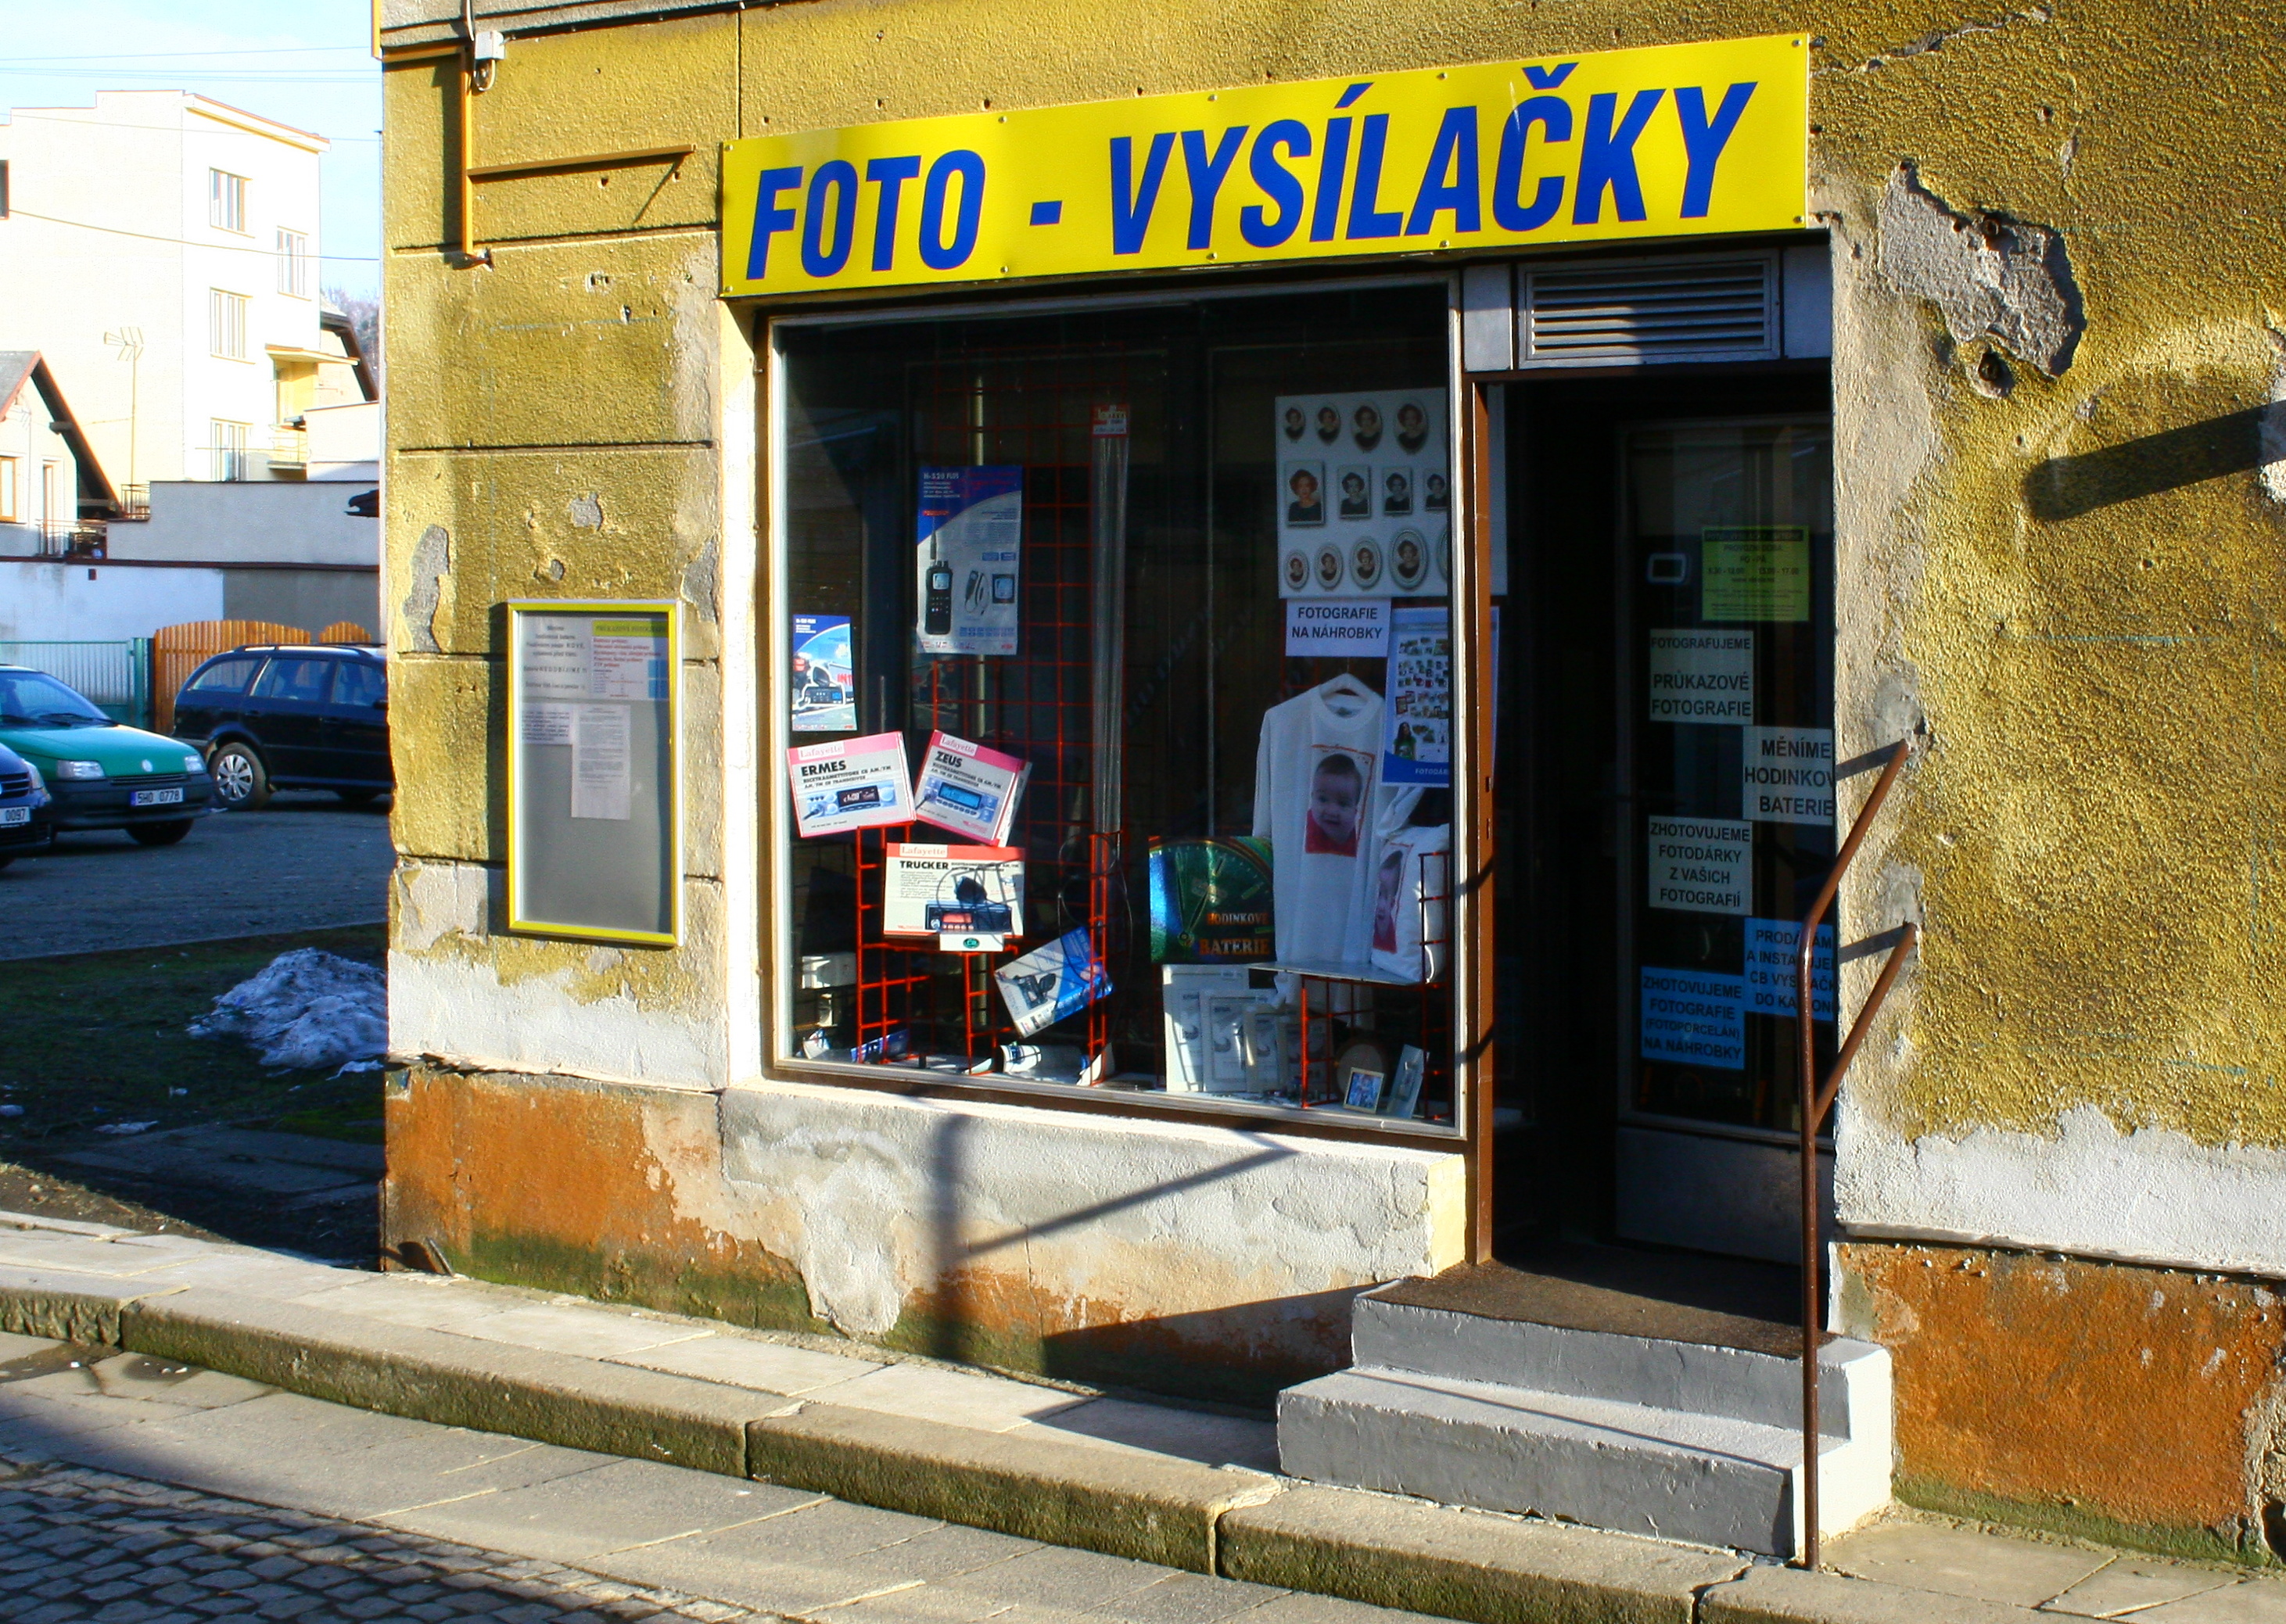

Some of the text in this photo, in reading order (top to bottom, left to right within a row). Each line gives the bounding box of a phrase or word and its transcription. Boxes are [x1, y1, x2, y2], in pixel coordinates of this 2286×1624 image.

[748, 151, 985, 279] FOTO
[1111, 63, 1757, 254] VYSÍLAČKY
[1297, 607, 1379, 619] FOTOGRAFIE
[1291, 624, 1383, 639] NA NÁHROBKY
[1651, 637, 1752, 650] FOTOGRAFUJEME
[1653, 669, 1750, 691] PRŮKAZOVÉ
[1651, 699, 1753, 717] FOTOGRAFIE
[800, 745, 843, 758] Lafayette
[942, 736, 975, 754] Lafayette
[1761, 736, 1832, 758] MĚNÍME
[801, 760, 847, 776] ERMES
[935, 751, 963, 768] ZEUS
[1744, 766, 1835, 787] HODINKOV
[160, 790, 180, 802] 0778
[1760, 795, 1836, 816] BATERIE
[5, 808, 26, 822] 0097
[1649, 822, 1751, 842] ZHOTOVUJEME
[901, 845, 946, 856] Lafayette
[1659, 844, 1742, 863] FOTODÁRKY
[900, 860, 949, 870] TRUCKER
[1669, 866, 1731, 884] Z VAŠICH
[1660, 887, 1742, 907] FOTOGRAFIÍ
[1199, 938, 1270, 956] BATERIE
[1746, 949, 1756, 963] A
[1749, 970, 1768, 985] CB
[1643, 977, 1742, 998] ZHOTOVUJEME
[1755, 991, 1775, 1007] DO
[1650, 998, 1735, 1020] FOTOGRAFIE
[1644, 1036, 1742, 1059] NA NÁHROBKY
